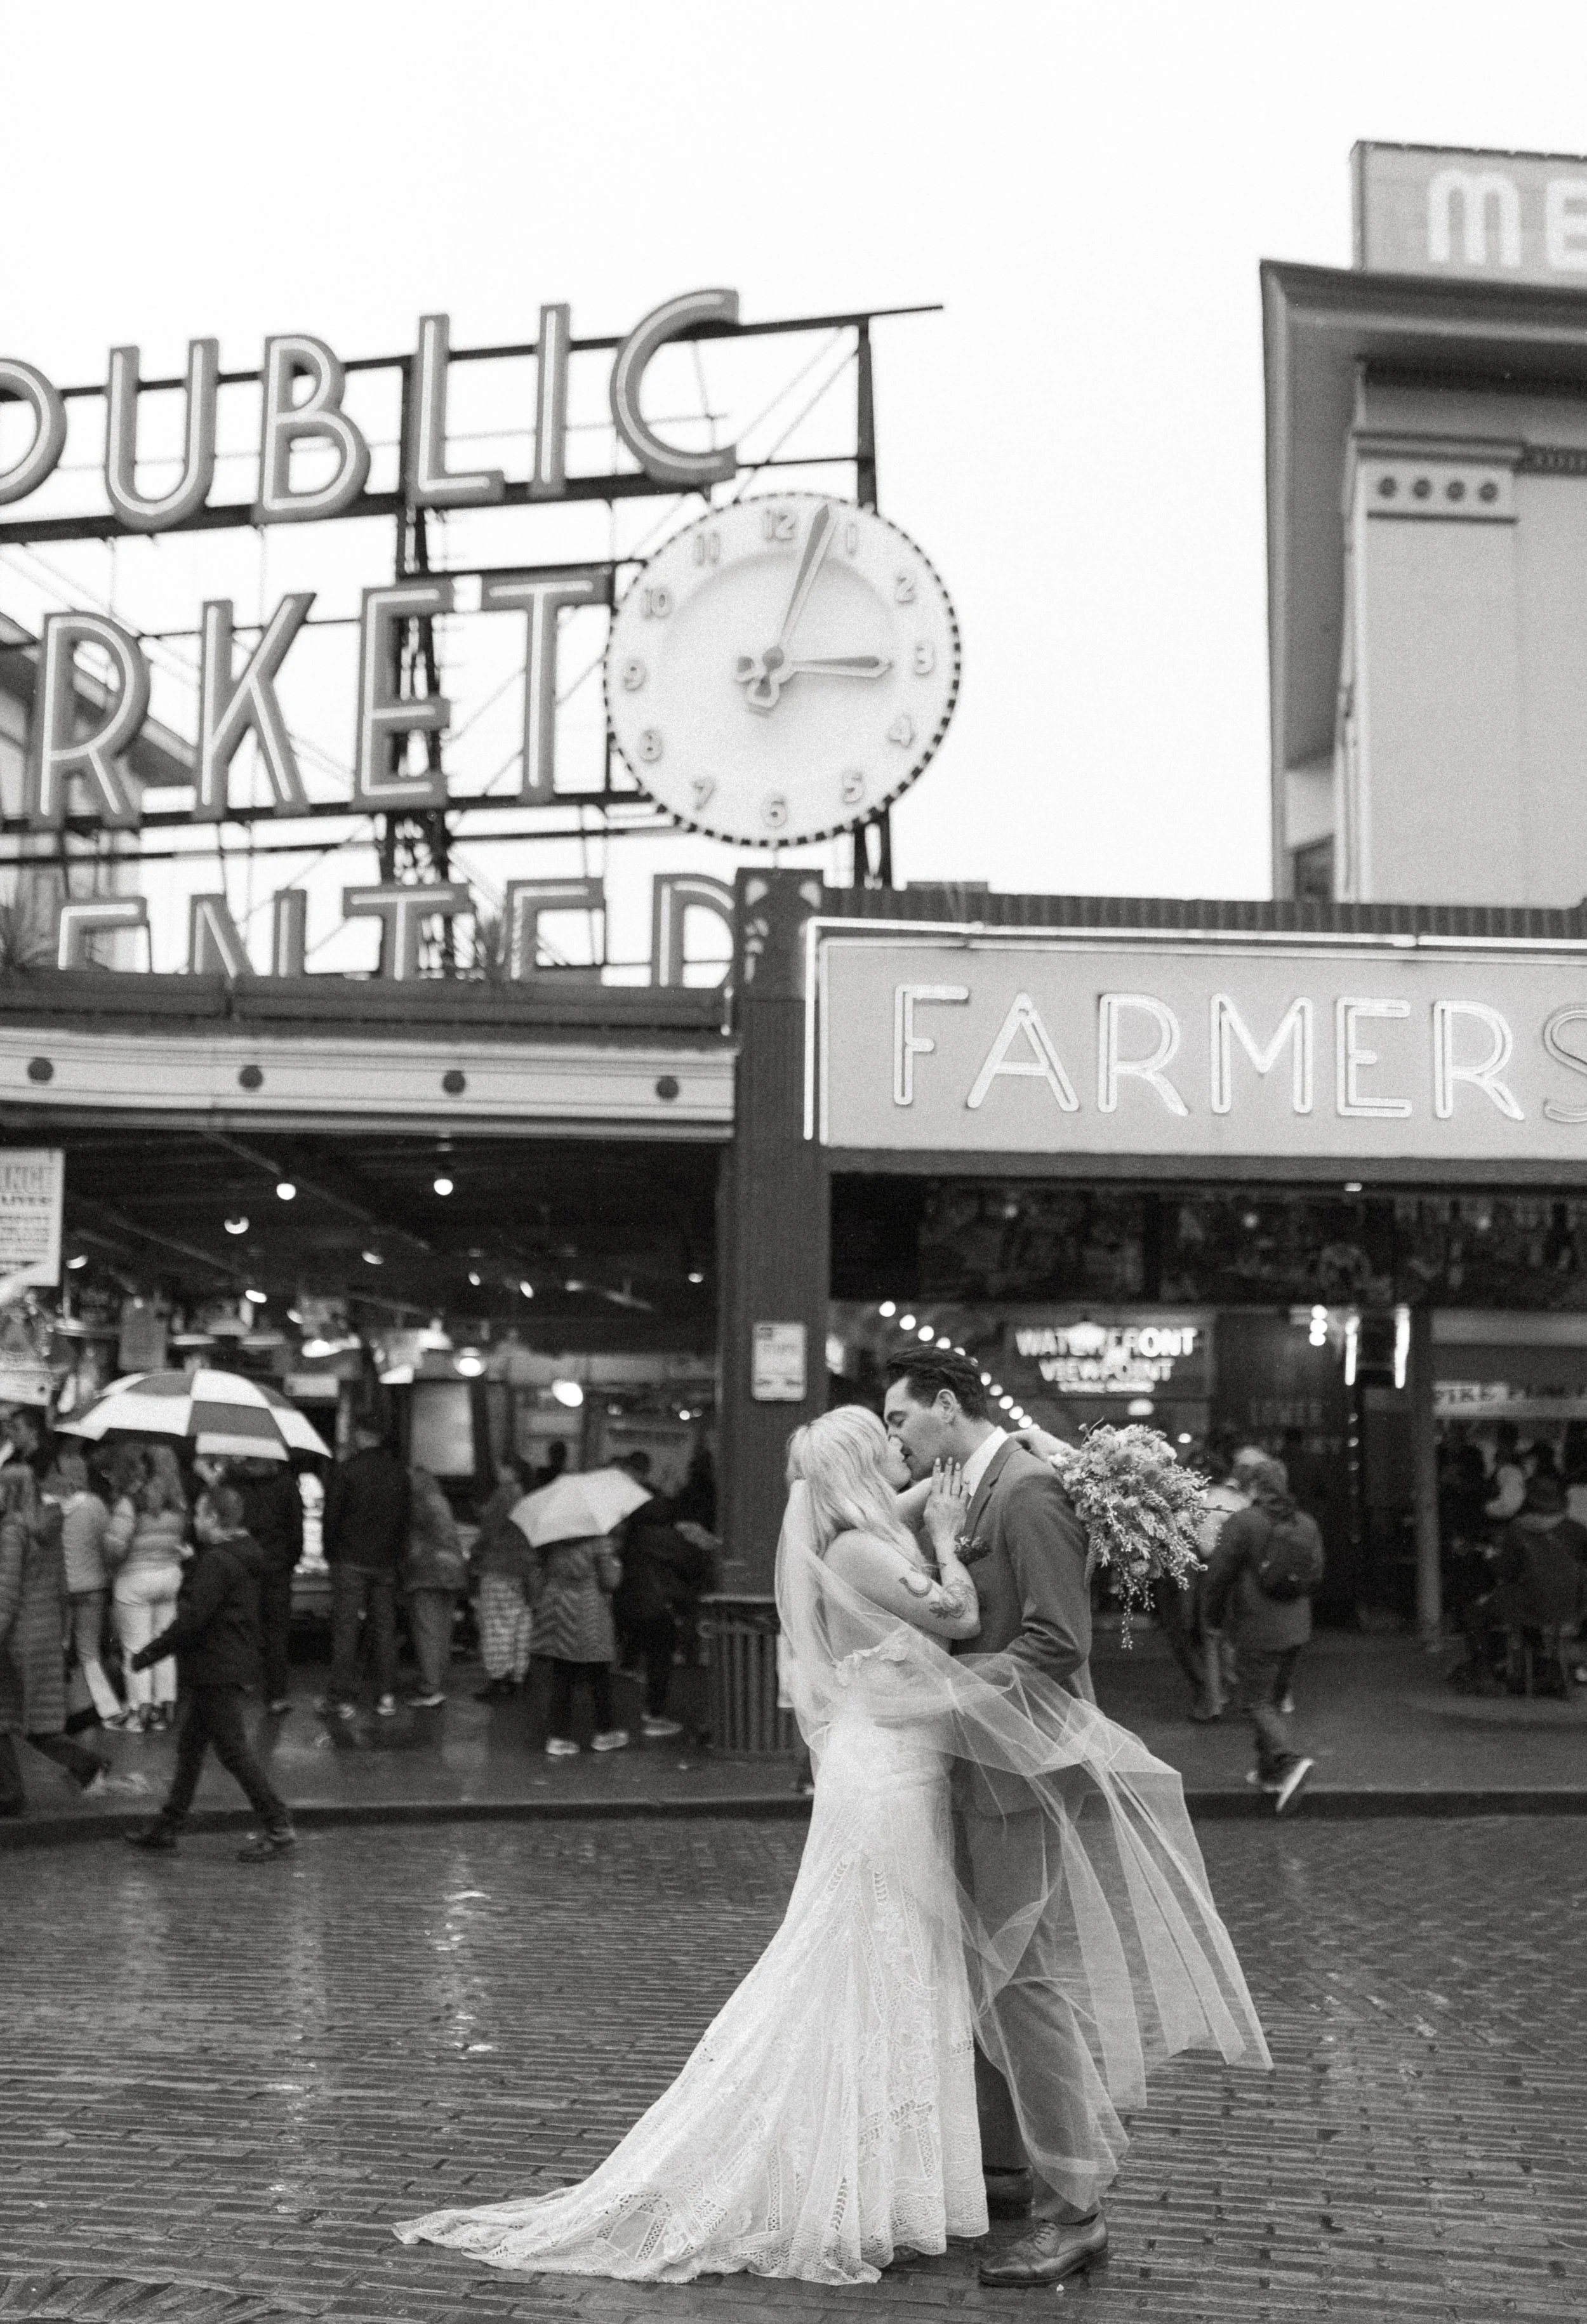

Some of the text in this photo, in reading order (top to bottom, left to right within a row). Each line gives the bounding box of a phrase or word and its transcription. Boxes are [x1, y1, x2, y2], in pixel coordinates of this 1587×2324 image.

[766, 507, 796, 541] 12
[698, 531, 722, 566] 11
[643, 585, 674, 619] 10
[894, 571, 917, 604] 2
[622, 656, 647, 691] 9
[914, 638, 936, 674] 3
[638, 727, 663, 764] 8
[889, 711, 913, 747] 4
[693, 774, 717, 811] 7
[841, 768, 866, 804] 5
[763, 793, 789, 827] 6
